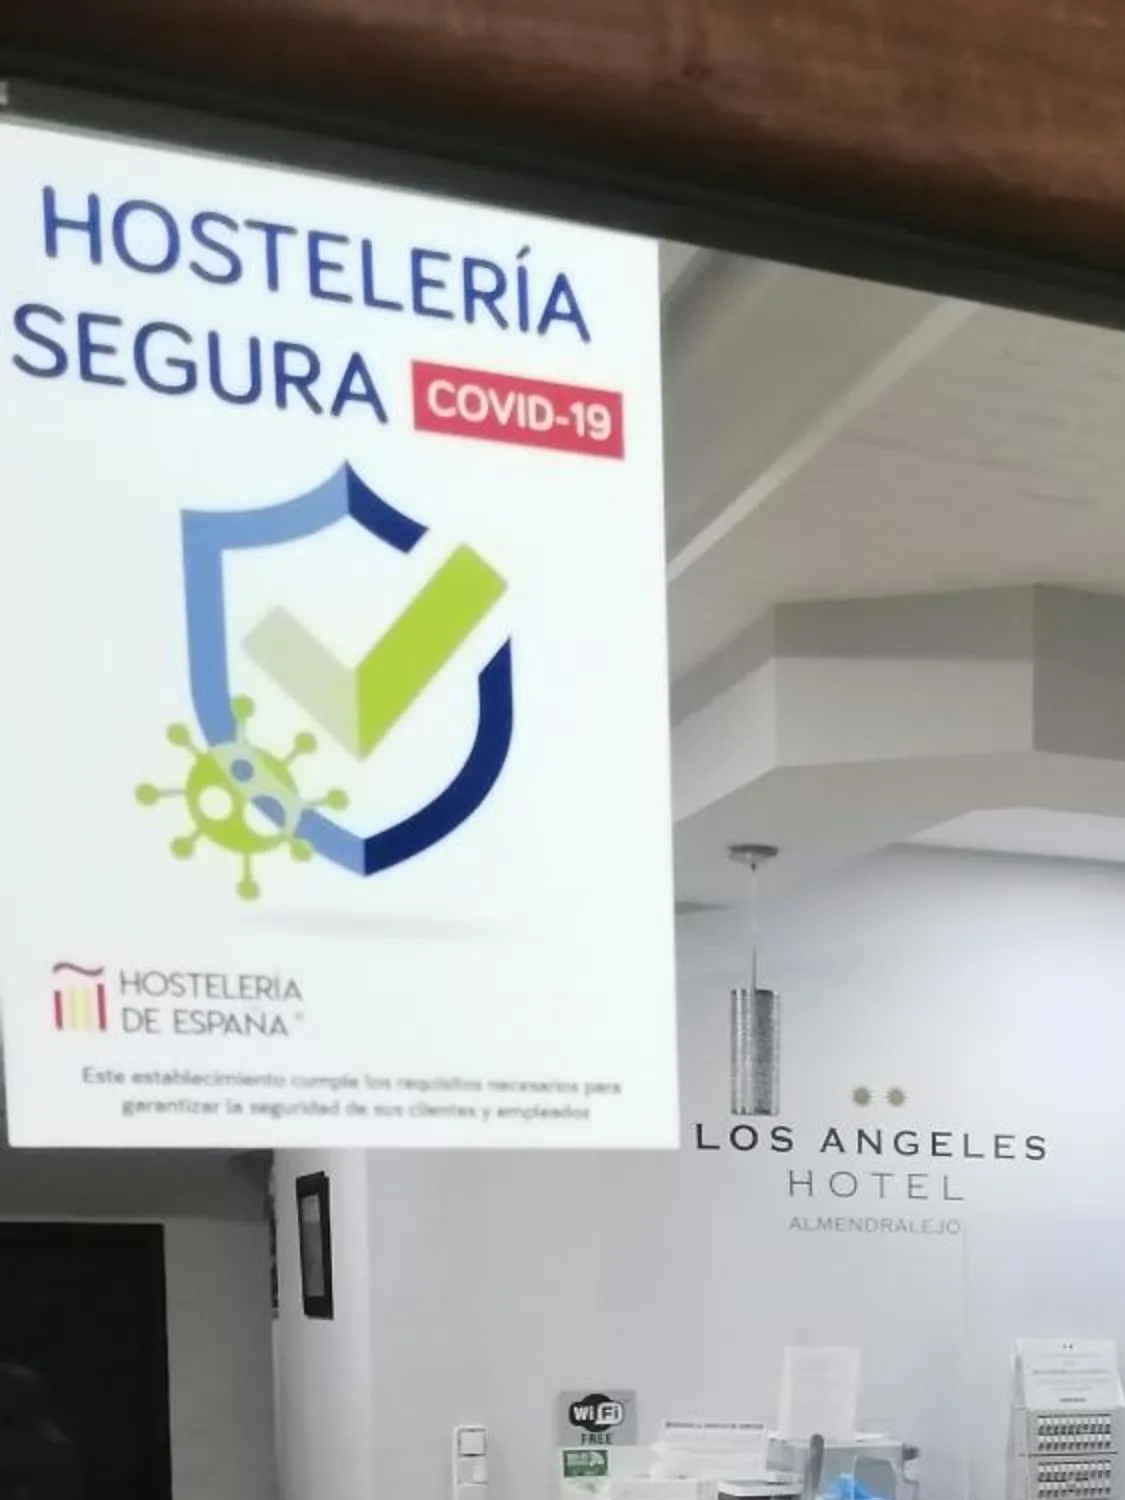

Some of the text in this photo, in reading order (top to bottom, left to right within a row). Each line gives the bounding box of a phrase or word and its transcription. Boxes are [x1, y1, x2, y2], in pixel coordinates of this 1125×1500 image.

[42, 184, 593, 344] HOSTELERÍA
[11, 301, 613, 441] SEGURA COVID-19
[119, 967, 304, 1001] HOSTELERÍA
[122, 1003, 289, 1036] DE ESPAÑA
[81, 1066, 125, 1085] Este
[695, 1123, 1048, 1161] LOS ANGELES
[787, 1169, 965, 1202] HOTEL
[788, 1216, 962, 1236] ALMENDRALEJO
